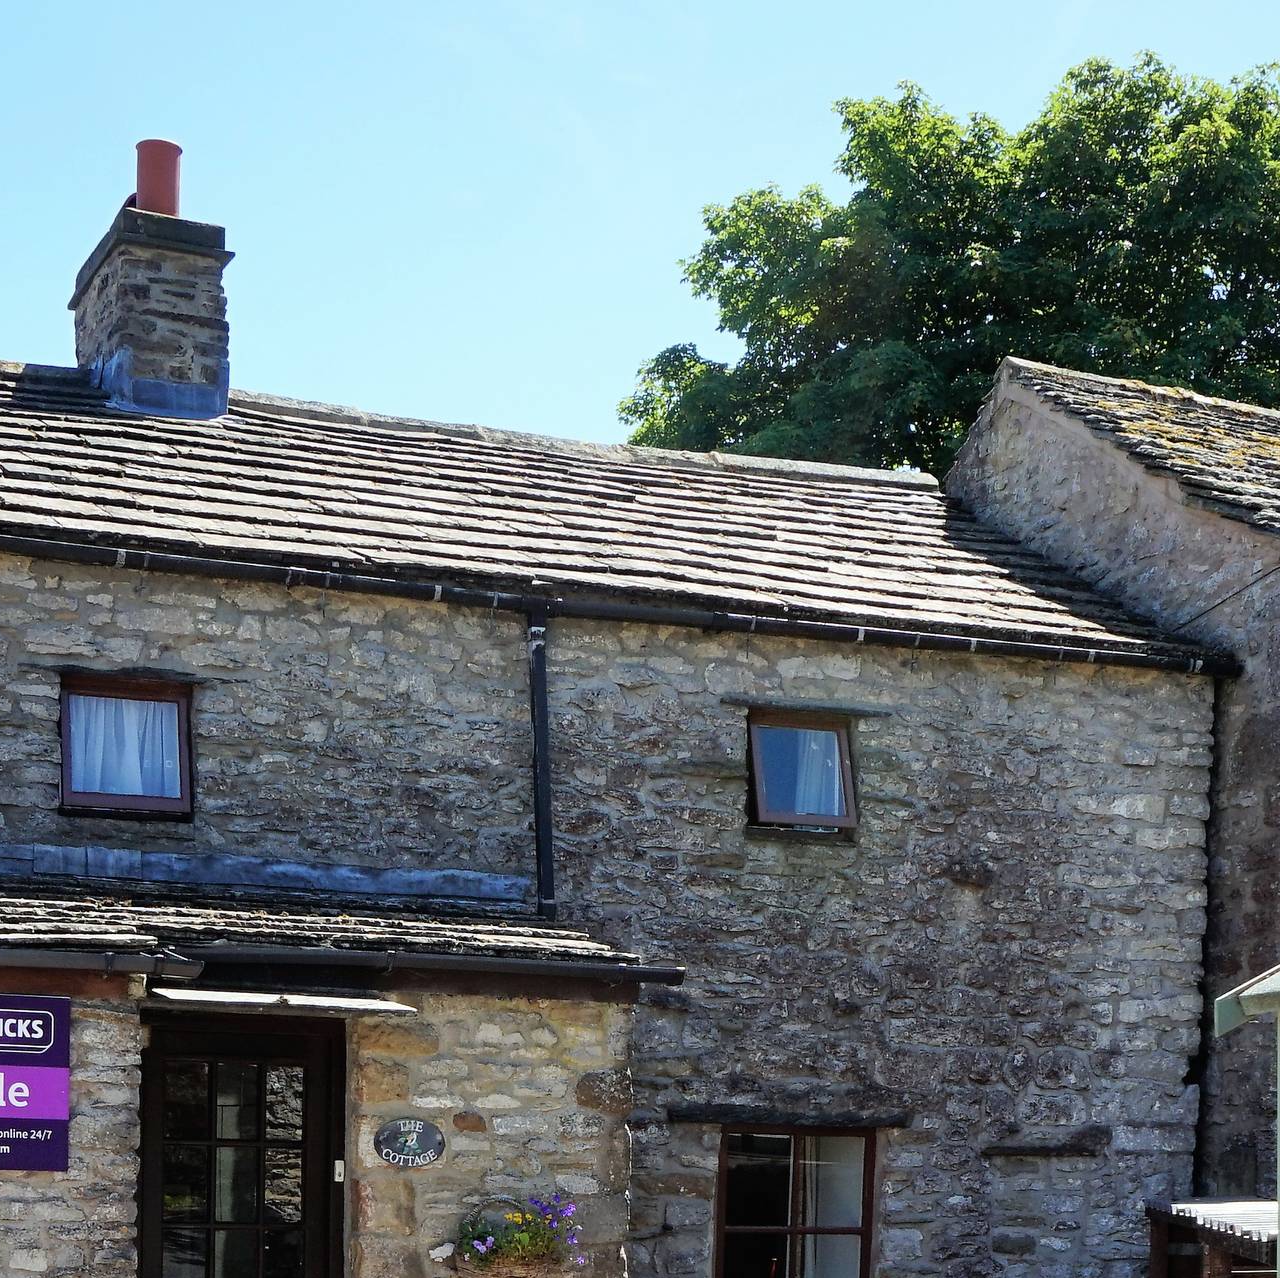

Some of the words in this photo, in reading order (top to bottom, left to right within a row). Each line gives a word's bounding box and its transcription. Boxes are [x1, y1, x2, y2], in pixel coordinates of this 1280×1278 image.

[398, 1120, 424, 1132] THE
[30, 1130, 52, 1141] 24/7
[382, 1148, 438, 1167] COTTAGE
